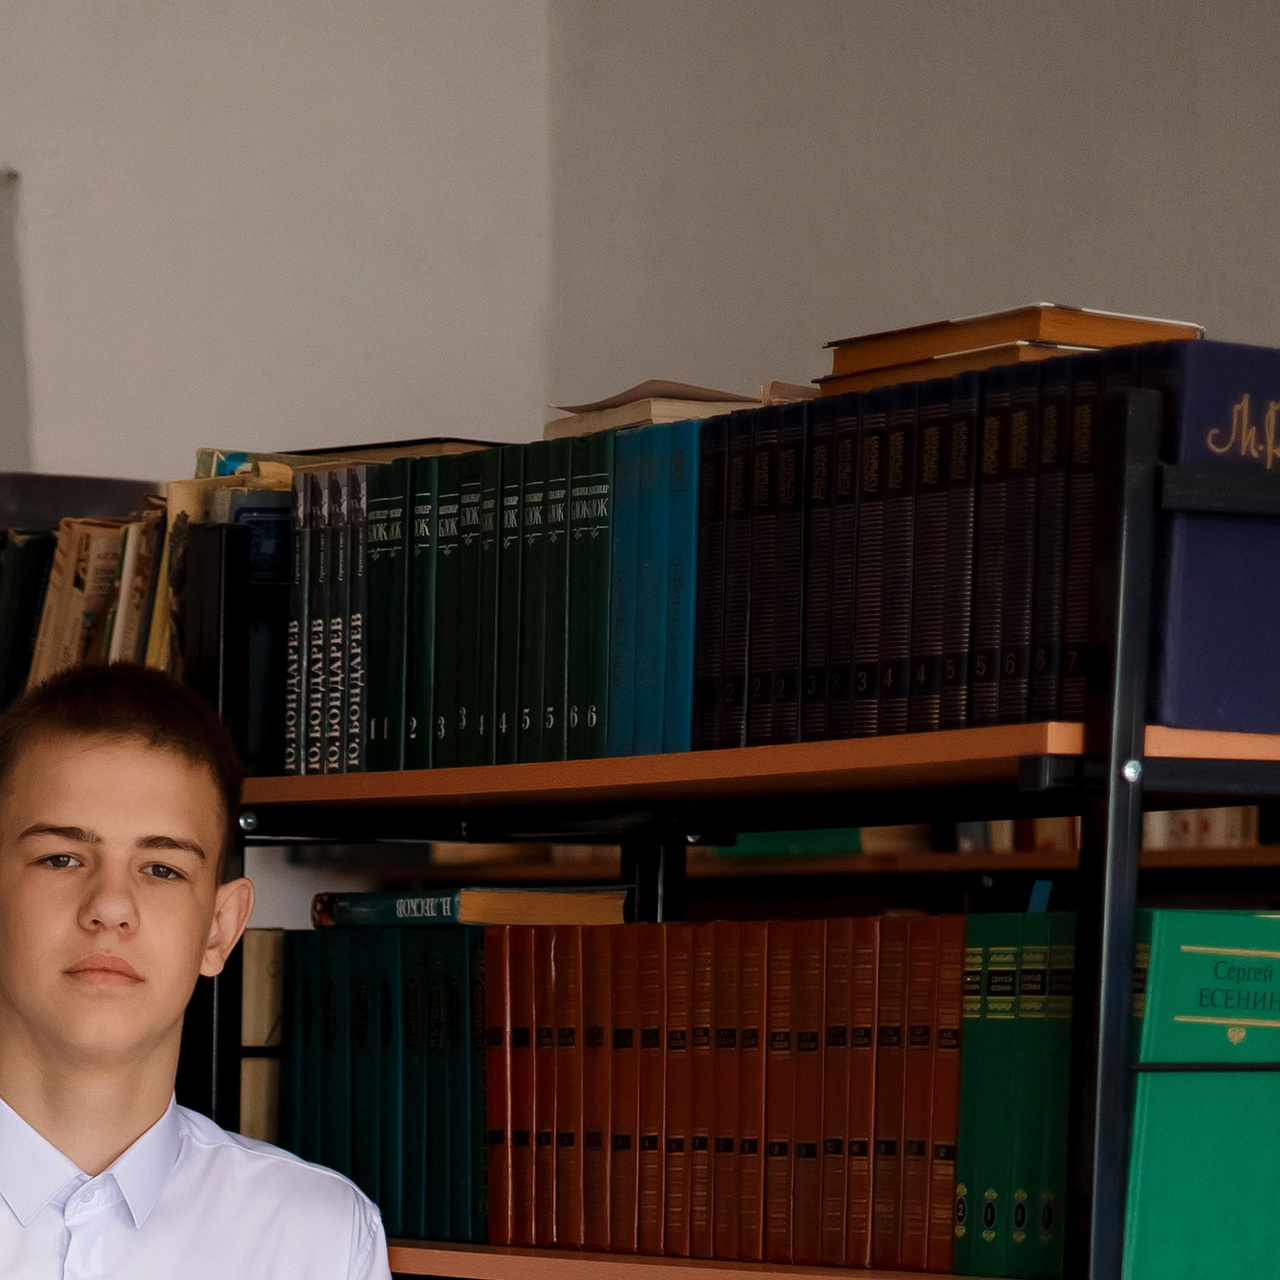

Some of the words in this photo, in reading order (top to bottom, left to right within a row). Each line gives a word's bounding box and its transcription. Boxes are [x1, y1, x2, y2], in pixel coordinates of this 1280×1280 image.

[285, 620, 301, 740] БОНДАРЕВ
[309, 618, 326, 739] БОНДАРЕВ
[327, 616, 345, 738] БОНДАРЕВ
[348, 612, 365, 735] БОНДАРЕВ
[396, 897, 438, 919] ЛЕСКОВ
[1198, 986, 1280, 1012] ЕСЕНИН
[1212, 960, 1274, 985] Сергей
